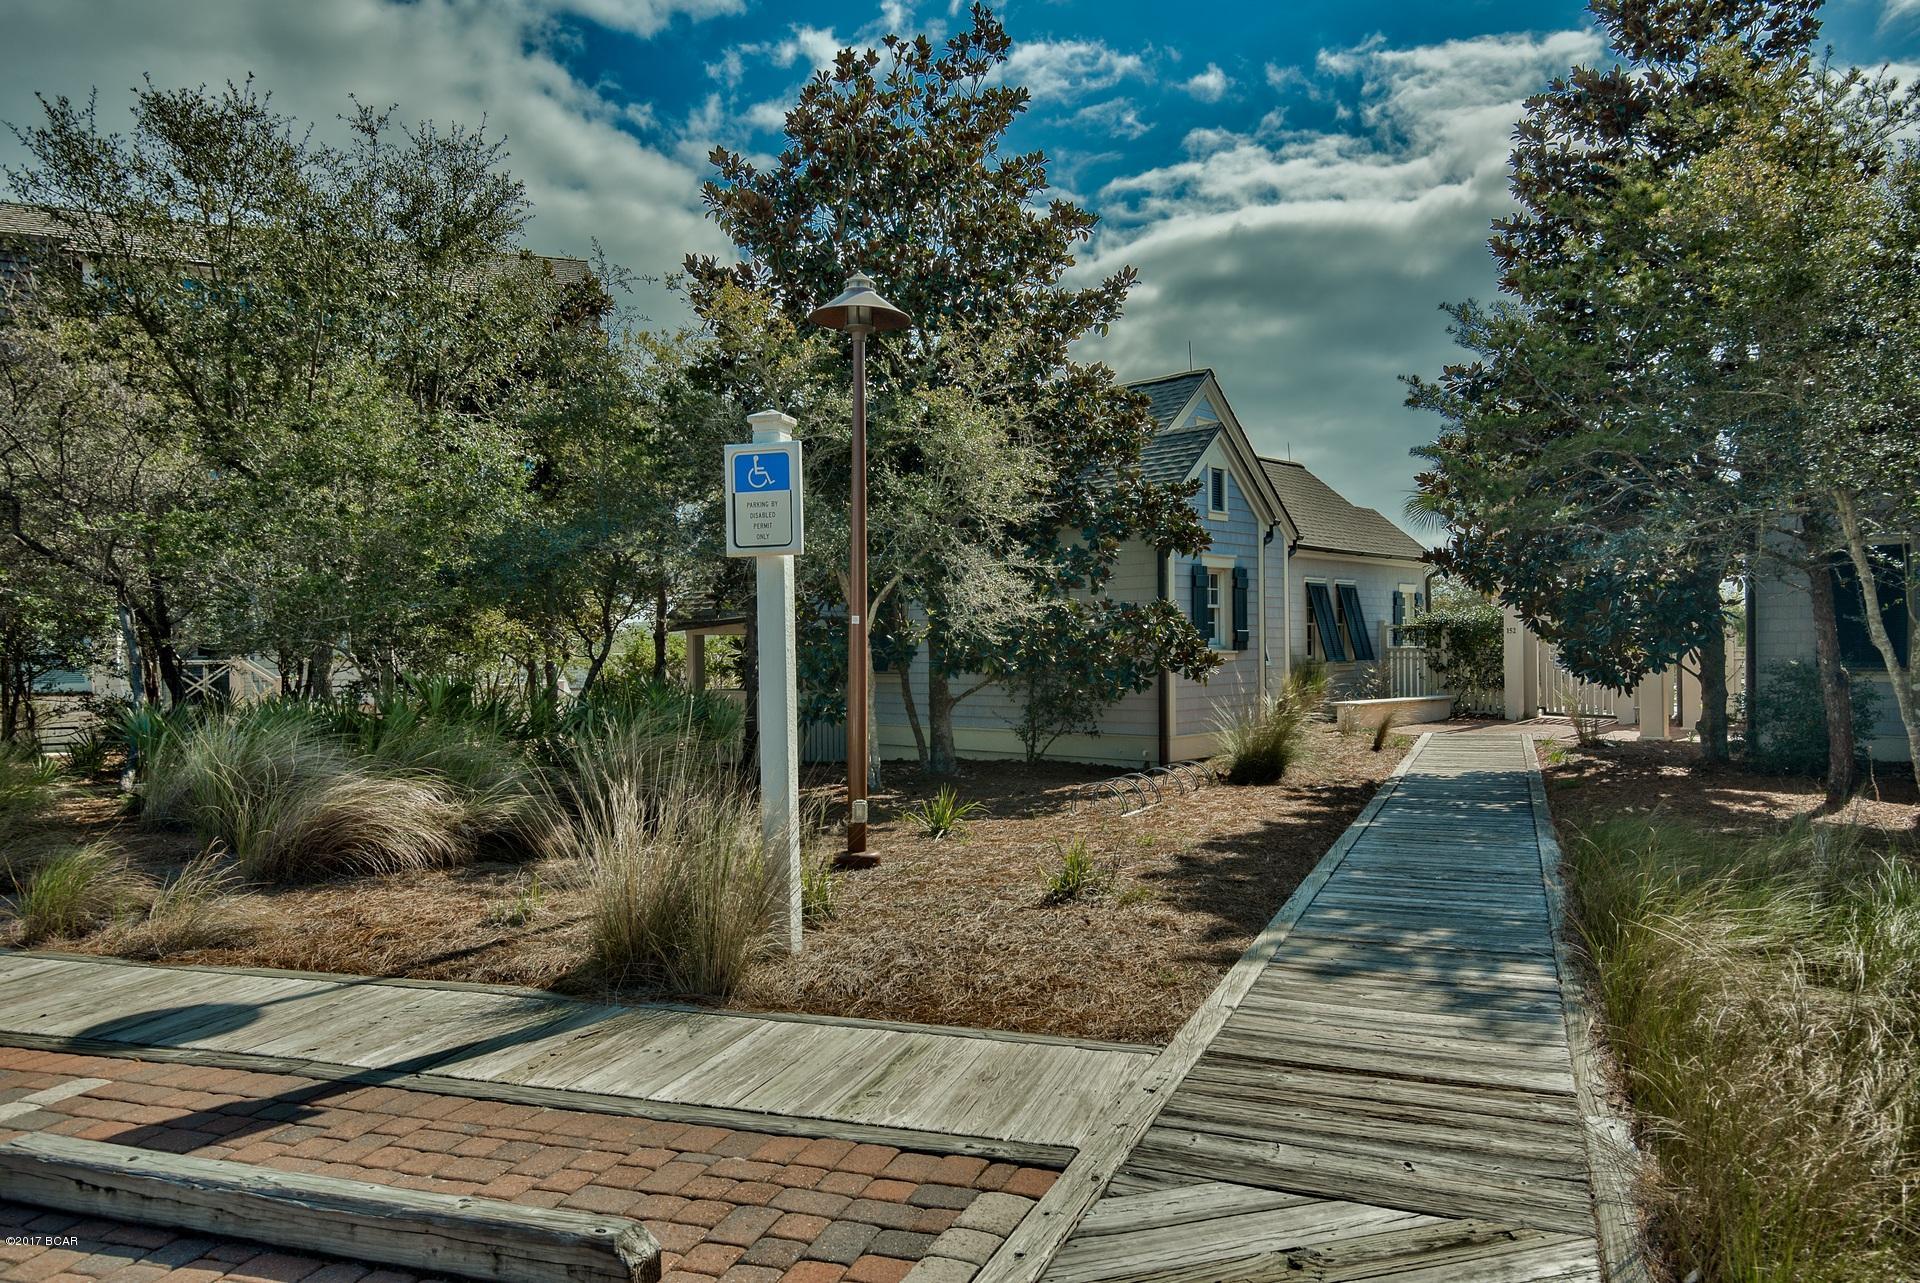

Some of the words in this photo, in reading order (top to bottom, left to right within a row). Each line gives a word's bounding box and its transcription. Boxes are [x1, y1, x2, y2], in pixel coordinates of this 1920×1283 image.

[749, 511, 776, 519] DISABLED
[753, 522, 773, 530] PERMIT
[756, 532, 770, 540] ONLY
